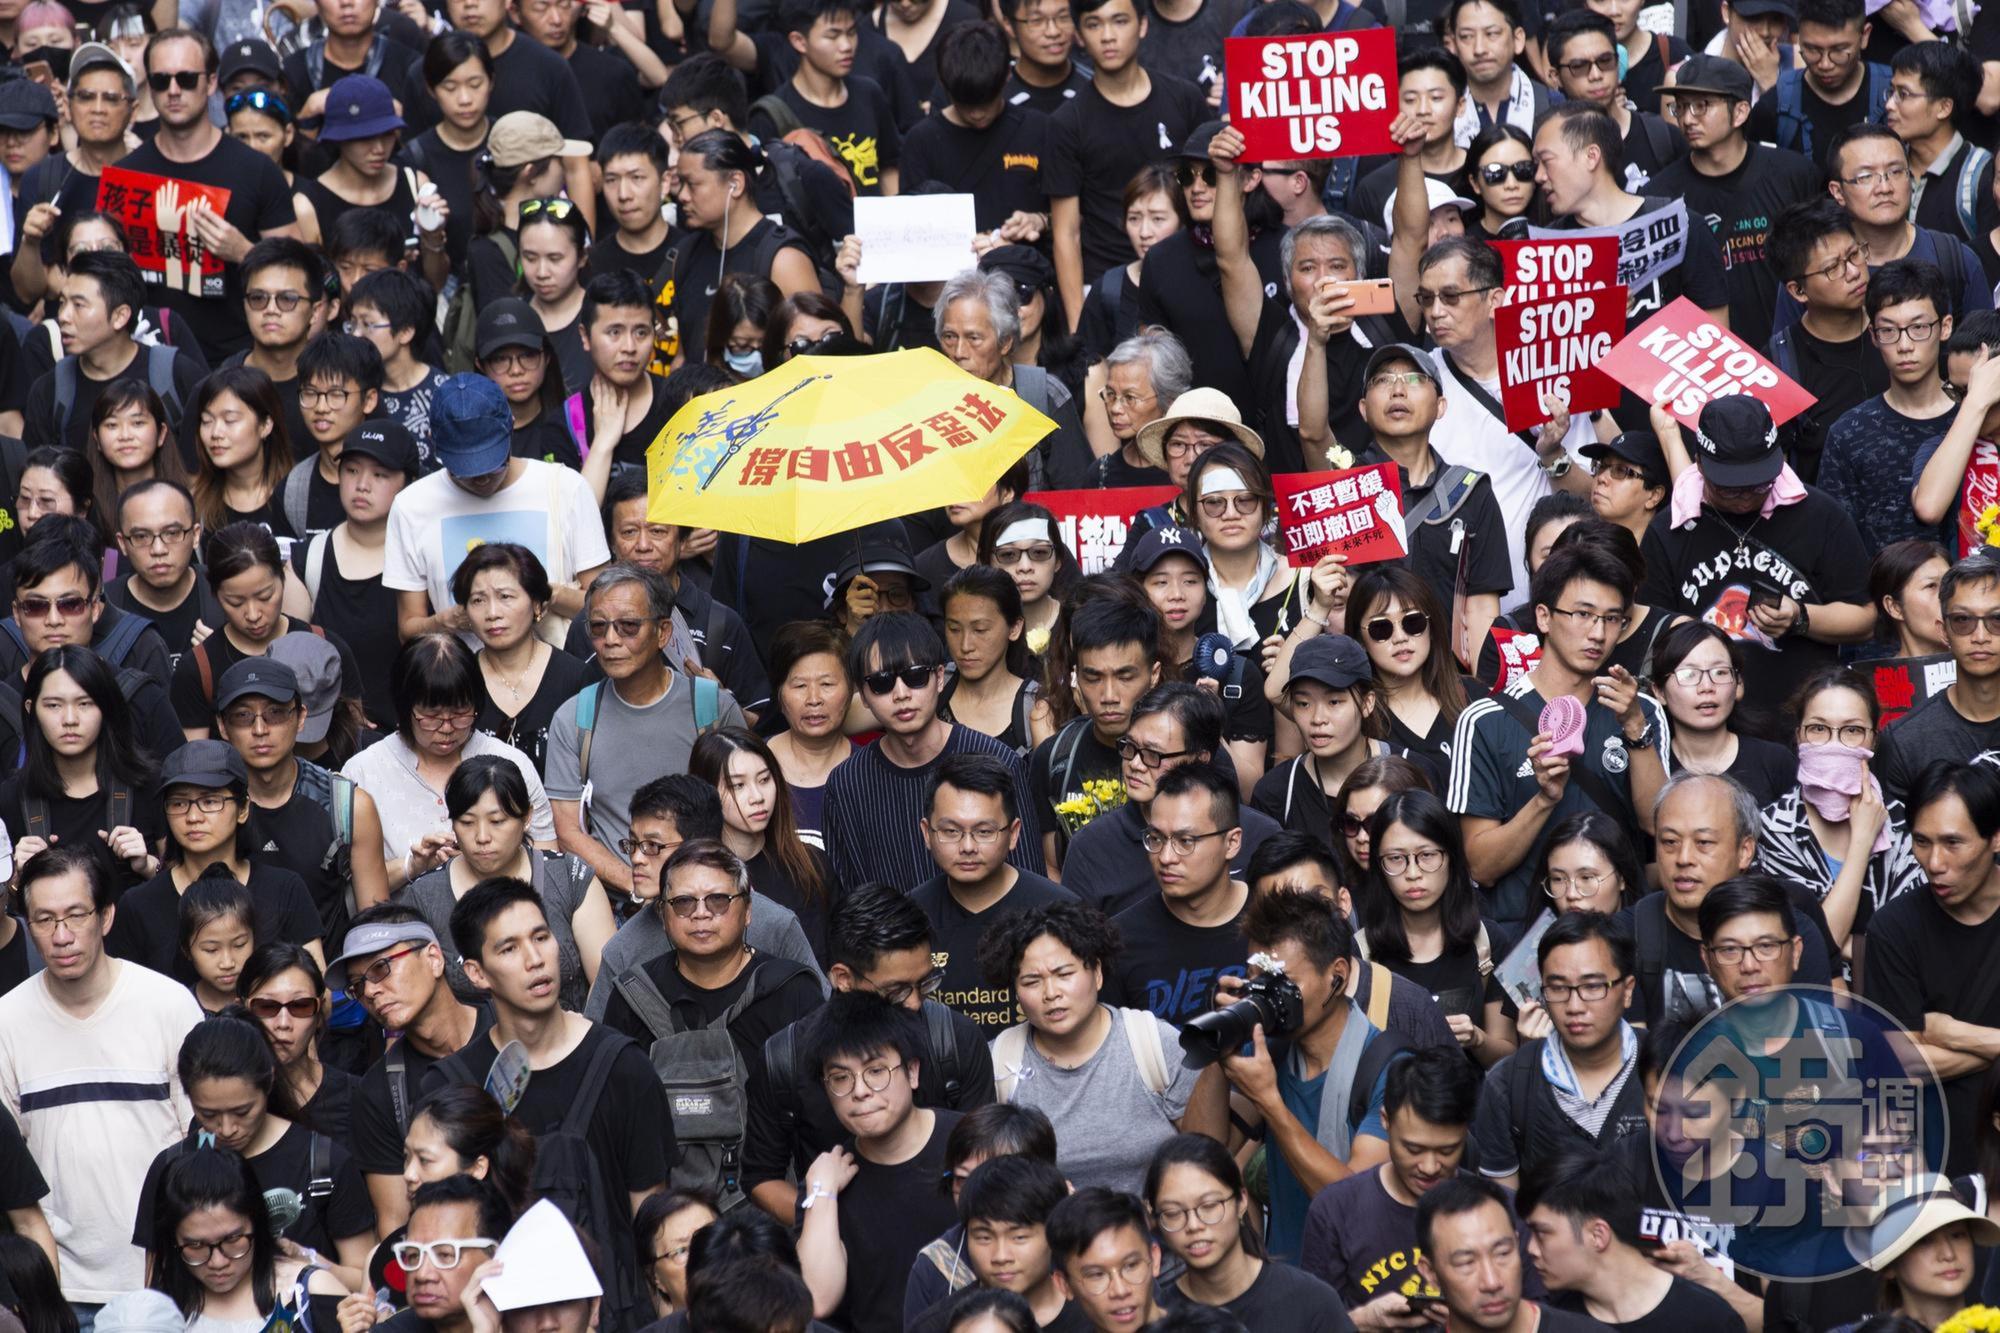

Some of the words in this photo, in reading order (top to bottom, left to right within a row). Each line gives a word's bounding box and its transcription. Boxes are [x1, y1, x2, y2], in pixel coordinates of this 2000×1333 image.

[1261, 37, 1359, 80] STOP
[1240, 72, 1387, 119] KILLING
[1289, 114, 1342, 154] US
[103, 182, 152, 219] 孩子
[1515, 243, 1594, 284] STOP
[1519, 297, 1595, 344] STOP
[1505, 331, 1613, 388] KILLING
[1687, 322, 1780, 389] STOP
[1535, 375, 1572, 417] US
[1652, 371, 1708, 417] US
[738, 391, 1007, 486] 撐自由反惡法
[1287, 468, 1385, 517] 不要暫緩
[1160, 527, 1181, 544] NY
[1285, 504, 1375, 553] 立即撤回
[927, 987, 1010, 1005] Standard
[1360, 1251, 1408, 1295] NYC
